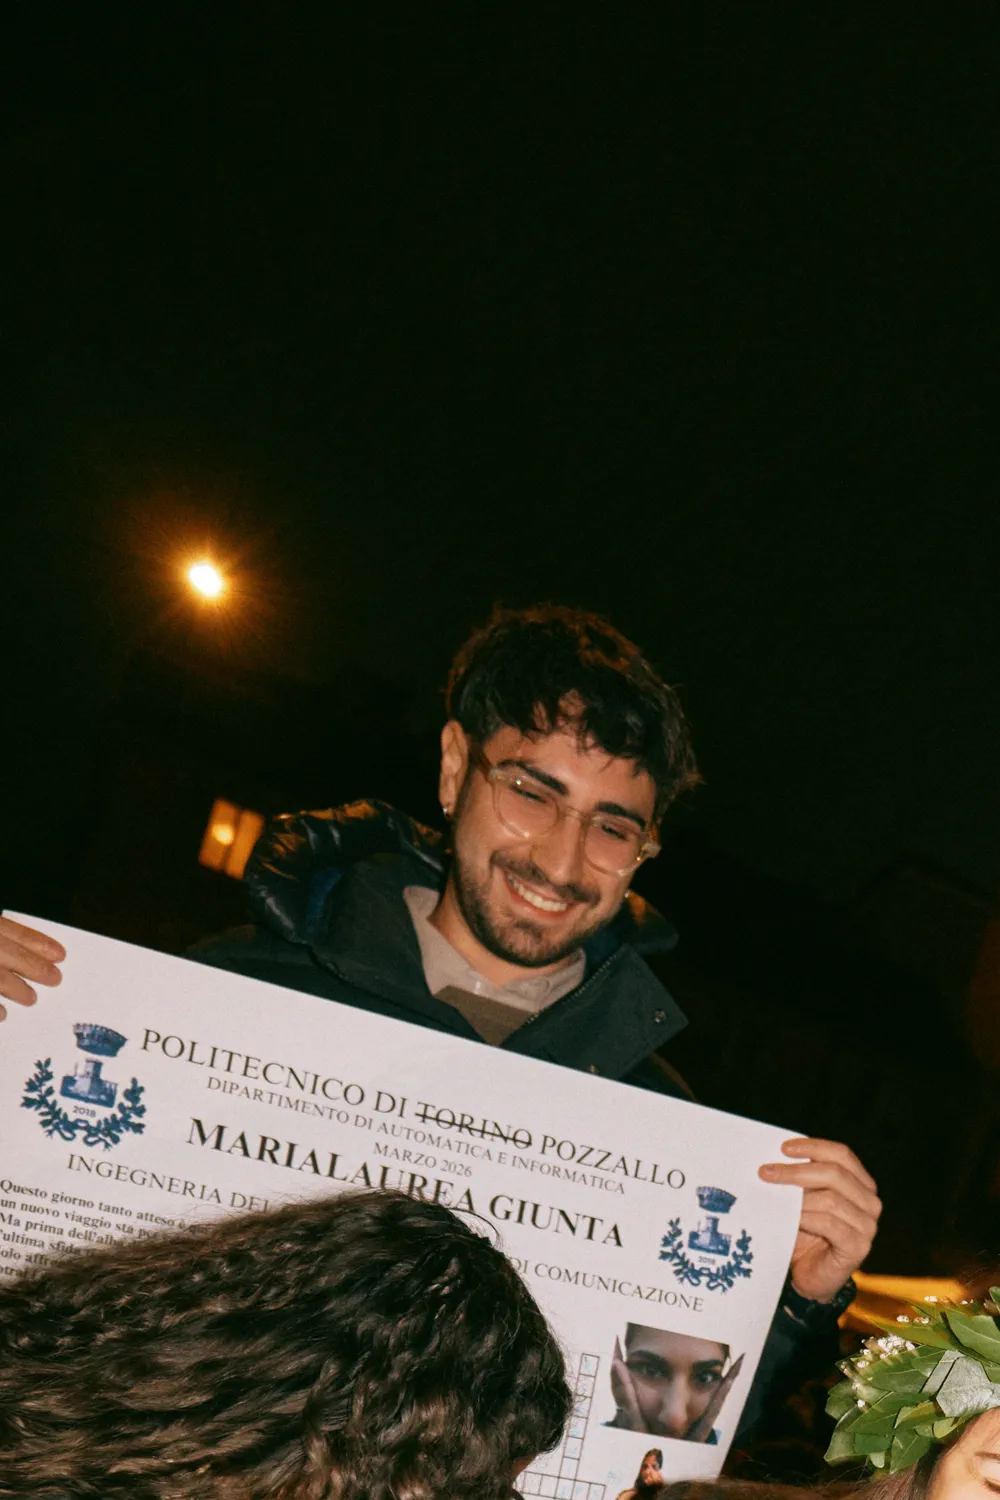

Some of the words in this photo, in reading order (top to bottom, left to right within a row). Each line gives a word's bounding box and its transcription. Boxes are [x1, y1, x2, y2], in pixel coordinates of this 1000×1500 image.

[140, 1028, 365, 1106] POLITECNICO
[373, 1090, 408, 1119] DI
[414, 1102, 532, 1149] TORINO
[540, 1134, 686, 1189] POZZALLO
[207, 1076, 349, 1124] DIPARTIMENTO
[354, 1114, 374, 1131] DI
[377, 1122, 492, 1161] AUTOMATICA
[498, 1151, 507, 1165] E
[511, 1155, 625, 1194] INFORMATICA
[67, 1154, 222, 1204] INGEGNERIA
[185, 1117, 477, 1212] MARIALAUREA
[490, 1194, 623, 1247] GIUNTA
[373, 1142, 437, 1168] MARZO
[440, 1159, 472, 1178] 2026
[0, 1179, 48, 1199] Questo
[51, 1191, 95, 1209] giorno
[98, 1201, 132, 1217] tanto
[136, 1209, 175, 1227] atteso
[20, 1203, 60, 1218] nuovo
[64, 1210, 112, 1231] viaggio
[25, 1218, 64, 1237] prima
[0, 1249, 21, 1261] olo
[534, 1262, 704, 1312] COMUNICAZIONE
